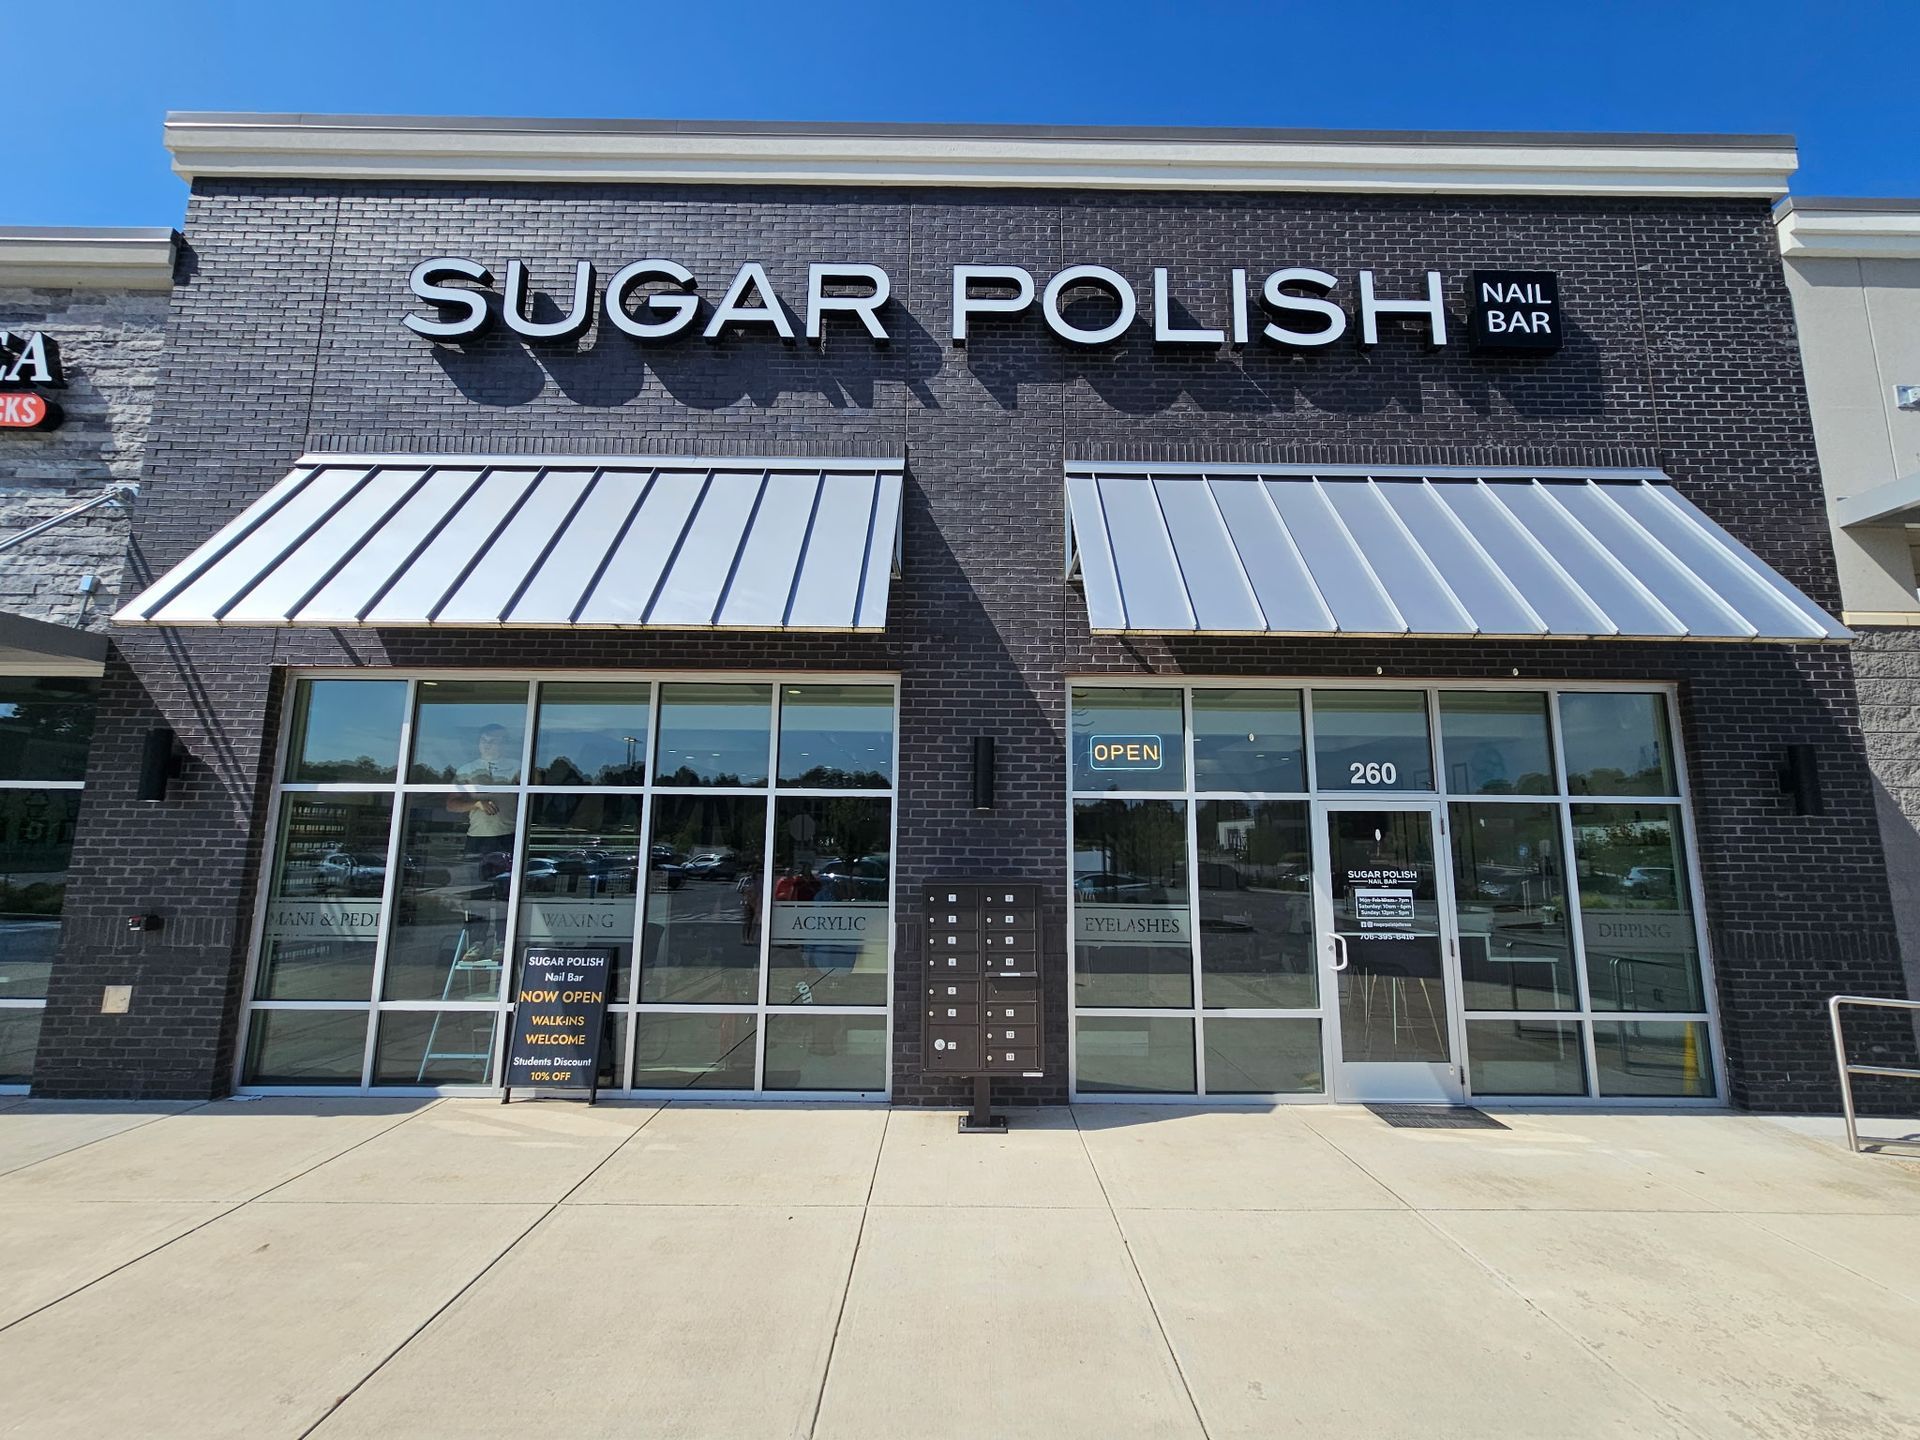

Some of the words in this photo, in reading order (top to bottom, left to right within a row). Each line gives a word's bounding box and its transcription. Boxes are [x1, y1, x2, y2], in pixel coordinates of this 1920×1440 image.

[1482, 282, 1552, 304] NAIL
[401, 258, 890, 342] SUGAR
[953, 264, 1447, 346] POLISH
[1487, 310, 1552, 334] BAR
[0, 397, 37, 424] KS
[1094, 744, 1159, 761] OPEN
[1349, 762, 1397, 785] 260
[1347, 870, 1381, 879] SUGAR
[1382, 870, 1418, 879] POLISH
[320, 912, 335, 927] &
[542, 912, 614, 928] WAXING
[792, 916, 866, 931] ACRYLIC
[1085, 917, 1180, 934] EYELASHES
[1598, 922, 1673, 938] DIPPING
[528, 956, 564, 967] SUGAR
[566, 957, 604, 967] POLISH
[545, 972, 565, 983] Nail
[567, 973, 584, 983] Bar
[520, 990, 559, 1004] NOW
[562, 991, 602, 1004] OPEN
[531, 1015, 585, 1026] WALK-INS
[526, 1034, 586, 1045] WELCOME
[513, 1056, 552, 1067] Students
[553, 1056, 592, 1067] Discount
[530, 1071, 550, 1081] 10%
[552, 1072, 571, 1081] OFF
